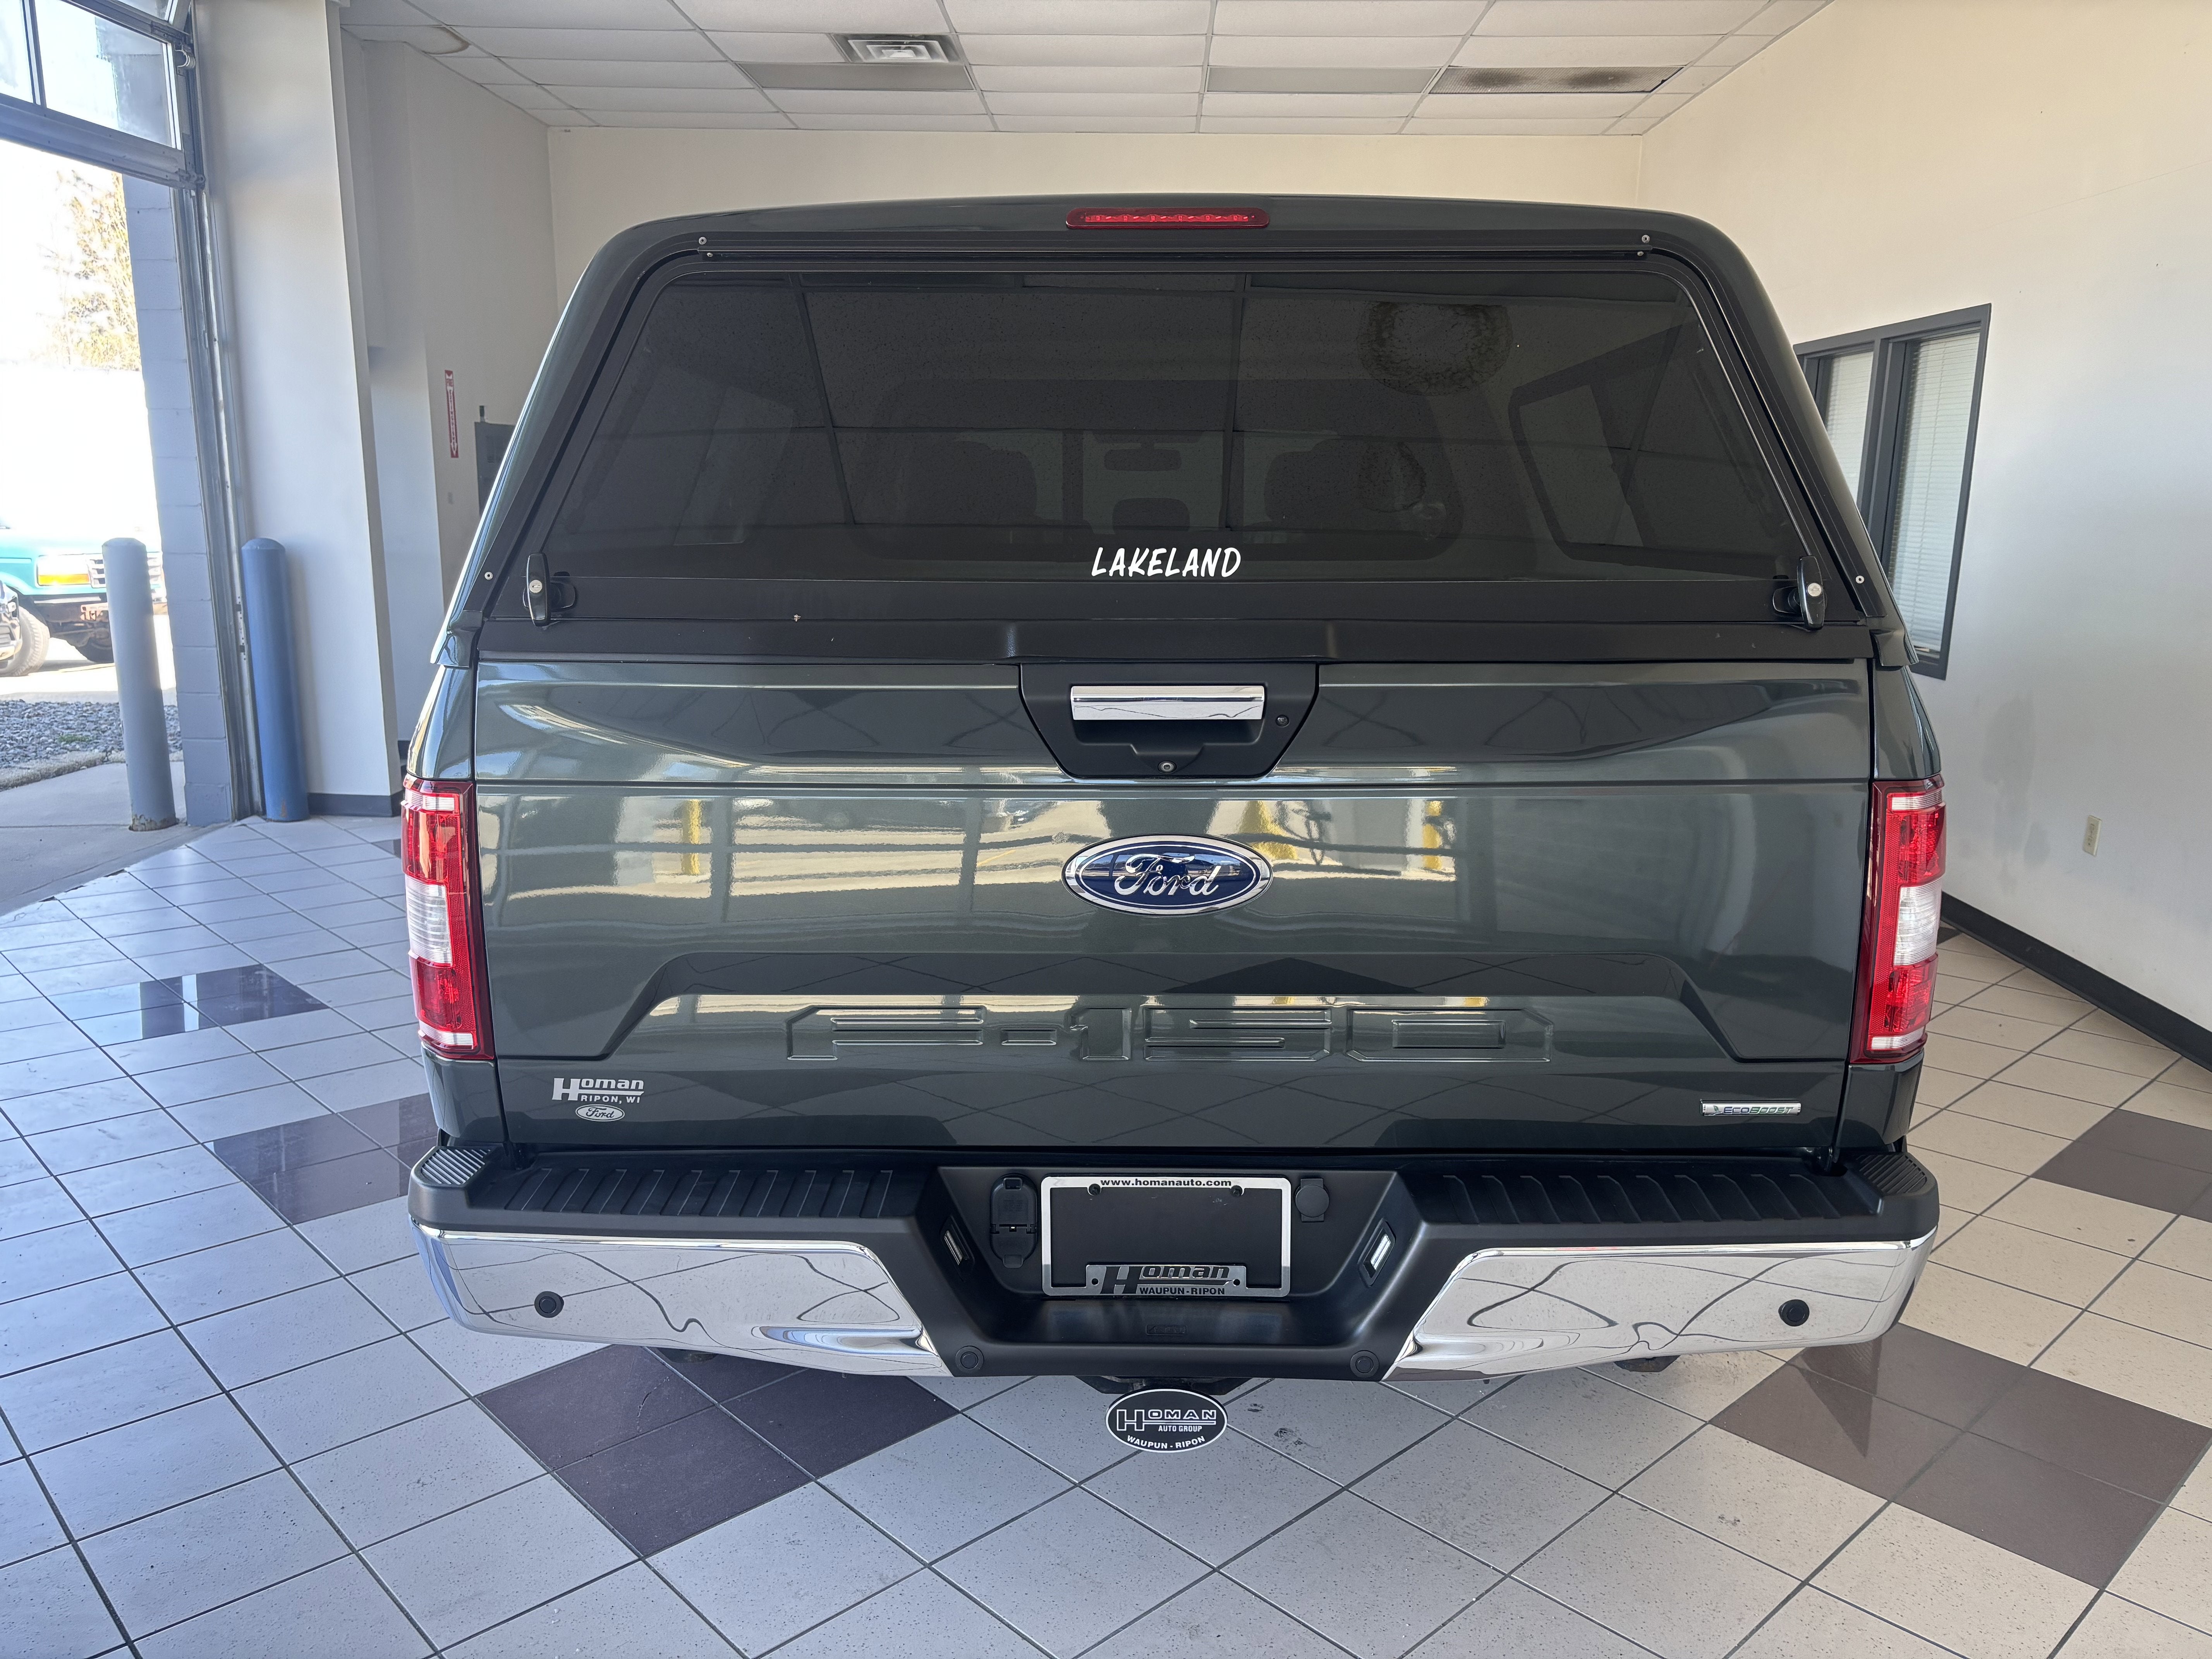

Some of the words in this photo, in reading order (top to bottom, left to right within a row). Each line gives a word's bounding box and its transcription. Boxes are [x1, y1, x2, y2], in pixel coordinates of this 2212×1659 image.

[1091, 547, 1241, 577] LAKELAND
[1114, 854, 1222, 896] Ford
[787, 1006, 1553, 1062] F-150
[552, 1078, 644, 1101] Homan
[581, 1095, 622, 1104] RIPON,
[586, 1107, 615, 1118] Ford
[1100, 1178, 1232, 1187] www.homanauto.com
[1100, 1266, 1230, 1294] Homan
[1116, 1409, 1217, 1431] HOMAN
[1127, 1435, 1168, 1449] WAUPUN
[1175, 1436, 1206, 1448] RIPON
